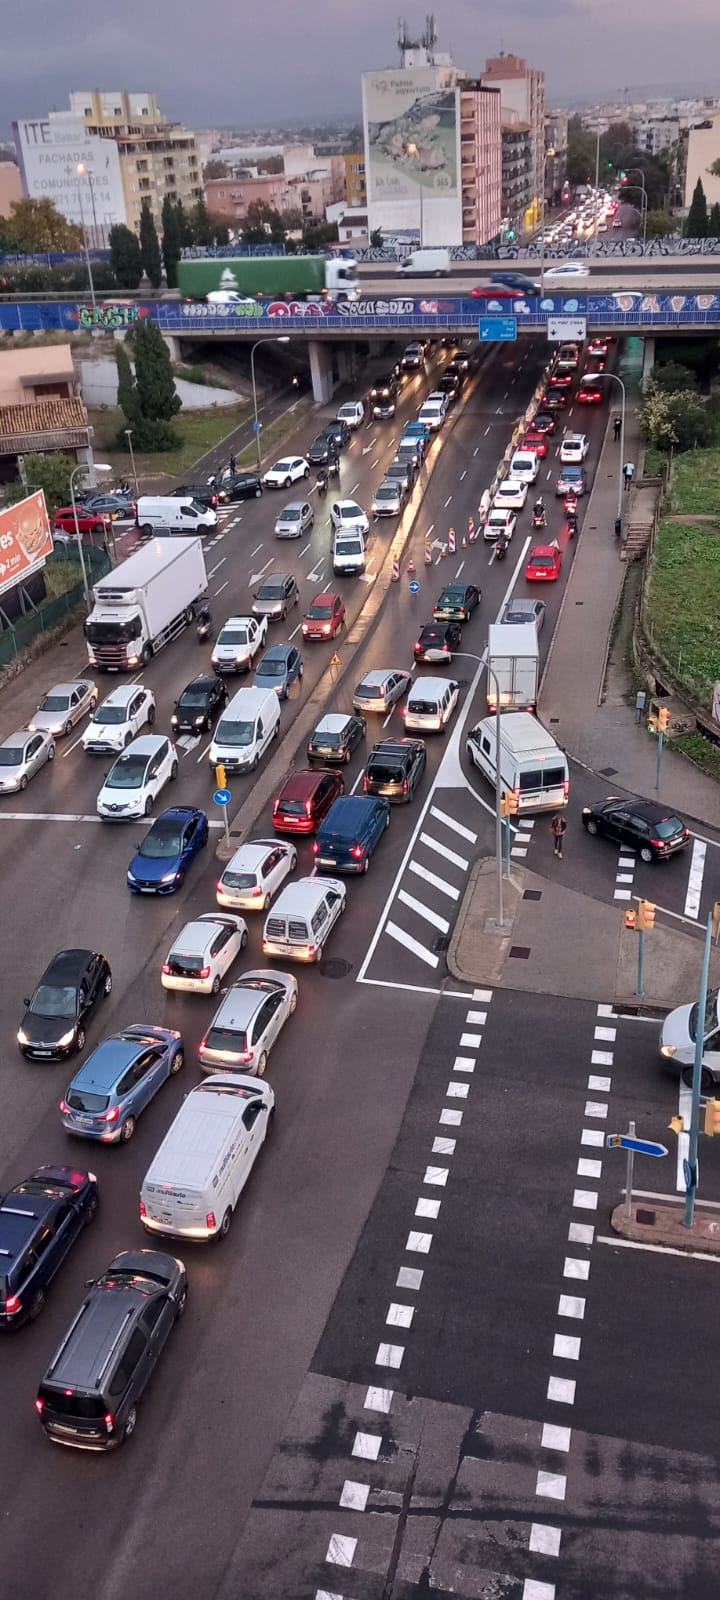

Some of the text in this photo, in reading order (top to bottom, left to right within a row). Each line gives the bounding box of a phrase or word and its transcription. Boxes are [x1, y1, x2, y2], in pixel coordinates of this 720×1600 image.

[24, 122, 51, 144] ITE
[38, 151, 95, 163] FACHADAS
[32, 175, 109, 190] COMUNIDADES
